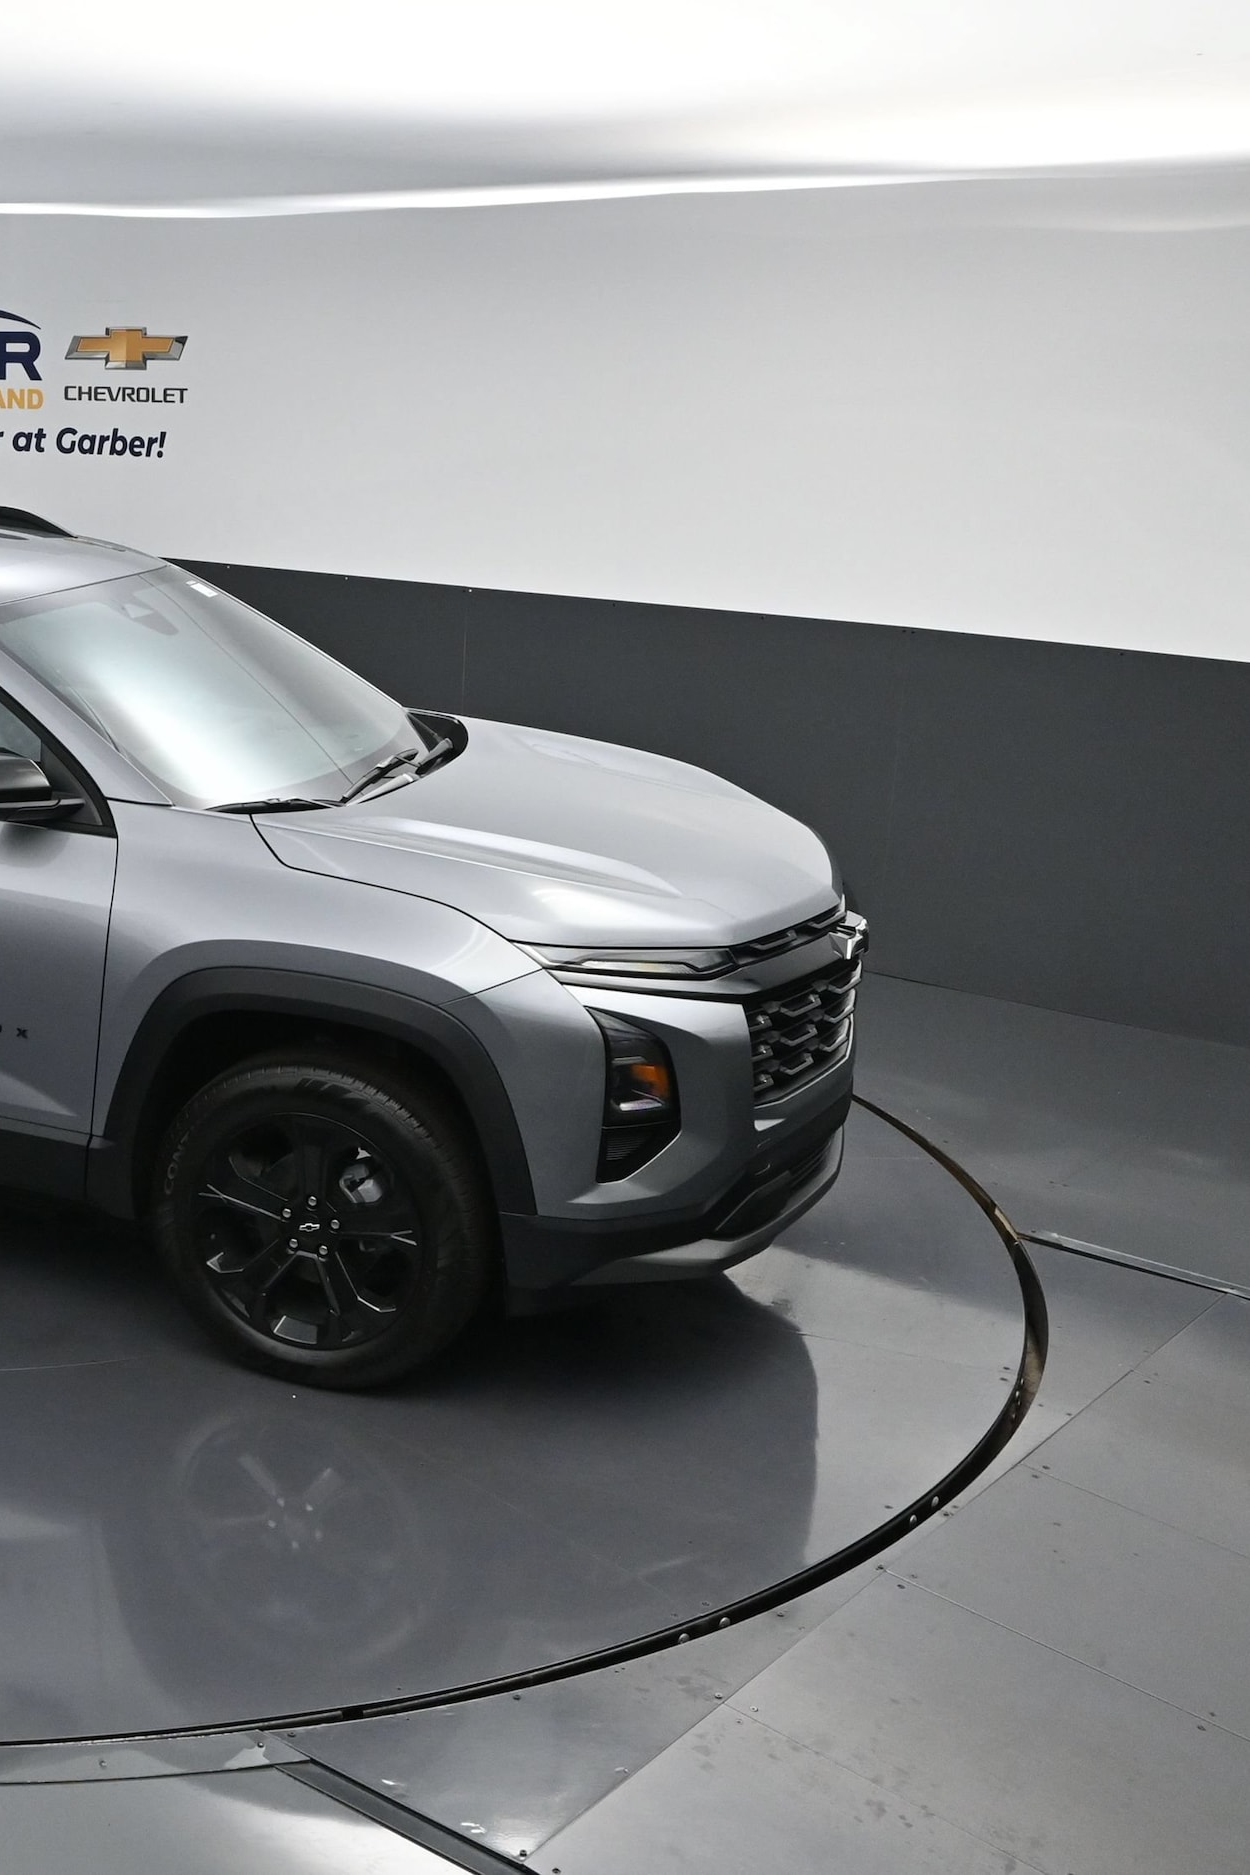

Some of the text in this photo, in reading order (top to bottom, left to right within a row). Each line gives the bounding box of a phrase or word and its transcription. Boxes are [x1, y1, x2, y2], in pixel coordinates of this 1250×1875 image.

[63, 385, 190, 404] CHEVROLET
[12, 427, 47, 453] at
[55, 427, 168, 459] Garber!
